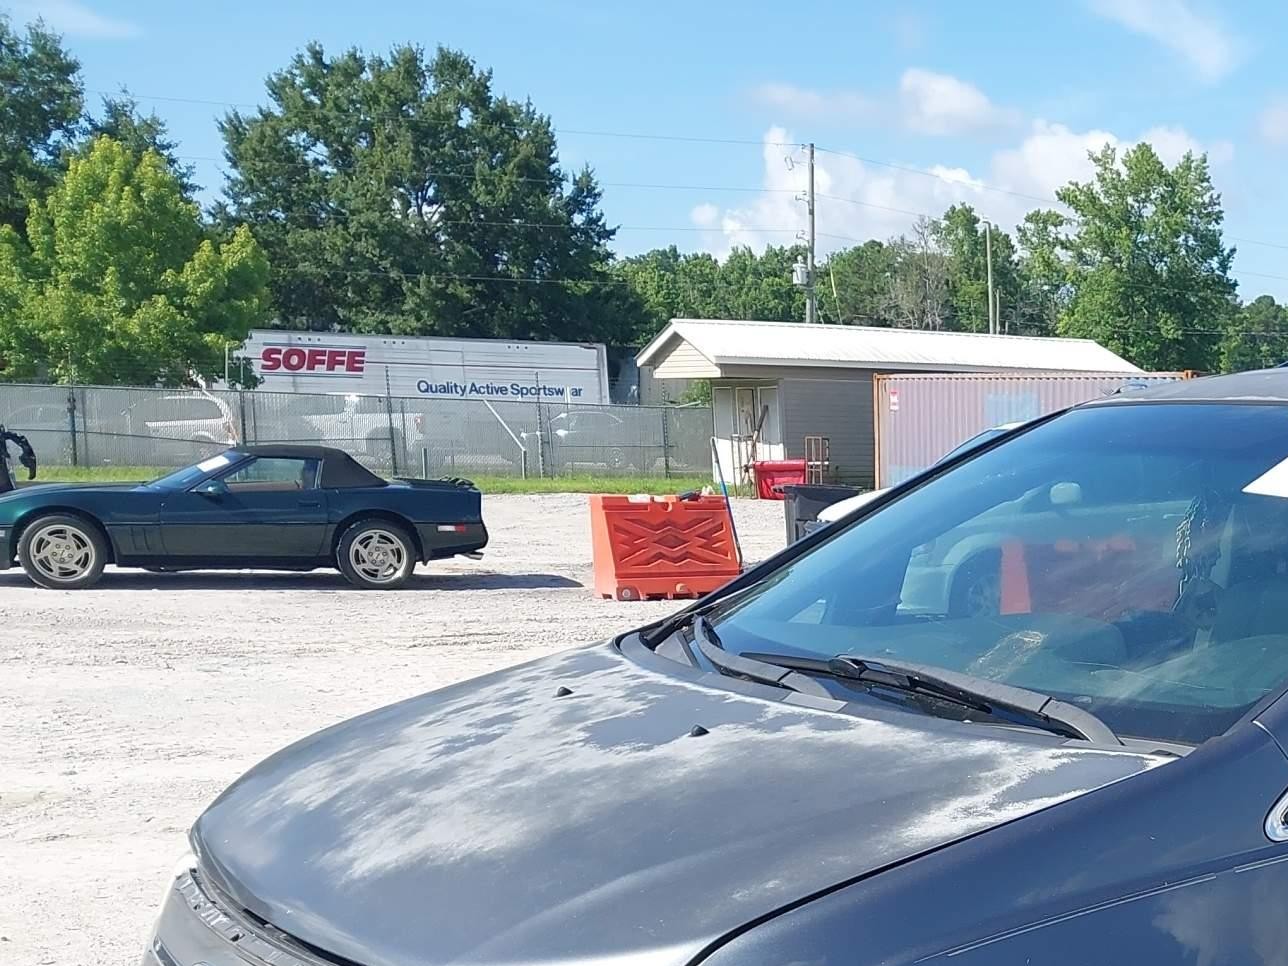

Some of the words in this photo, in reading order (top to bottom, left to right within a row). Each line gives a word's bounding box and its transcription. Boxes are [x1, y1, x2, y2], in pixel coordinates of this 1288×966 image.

[261, 347, 365, 372] SOFFE
[417, 380, 466, 396] Quality
[469, 382, 508, 396] Active
[510, 383, 583, 398] Sportswar
